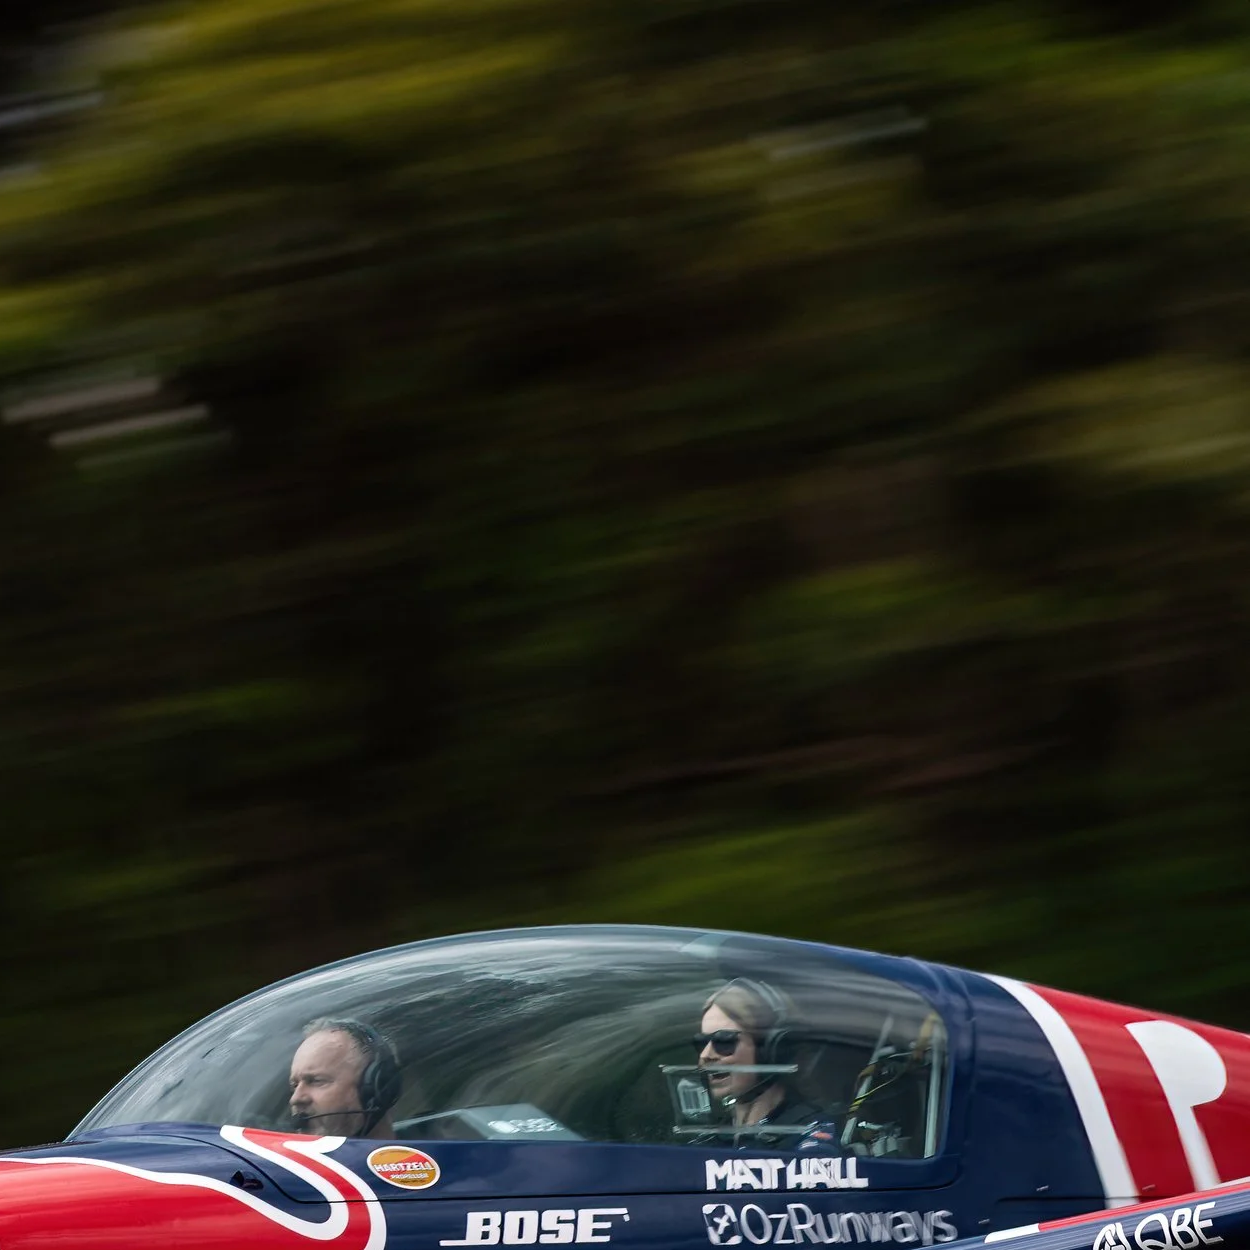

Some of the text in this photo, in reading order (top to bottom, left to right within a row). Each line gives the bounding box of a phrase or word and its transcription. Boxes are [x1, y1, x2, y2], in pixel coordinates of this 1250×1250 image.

[373, 1161, 436, 1172] HARTZELL
[705, 1157, 869, 1190] MATT HALL
[439, 1208, 630, 1246] BOSE
[740, 1203, 958, 1246] OzRunways
